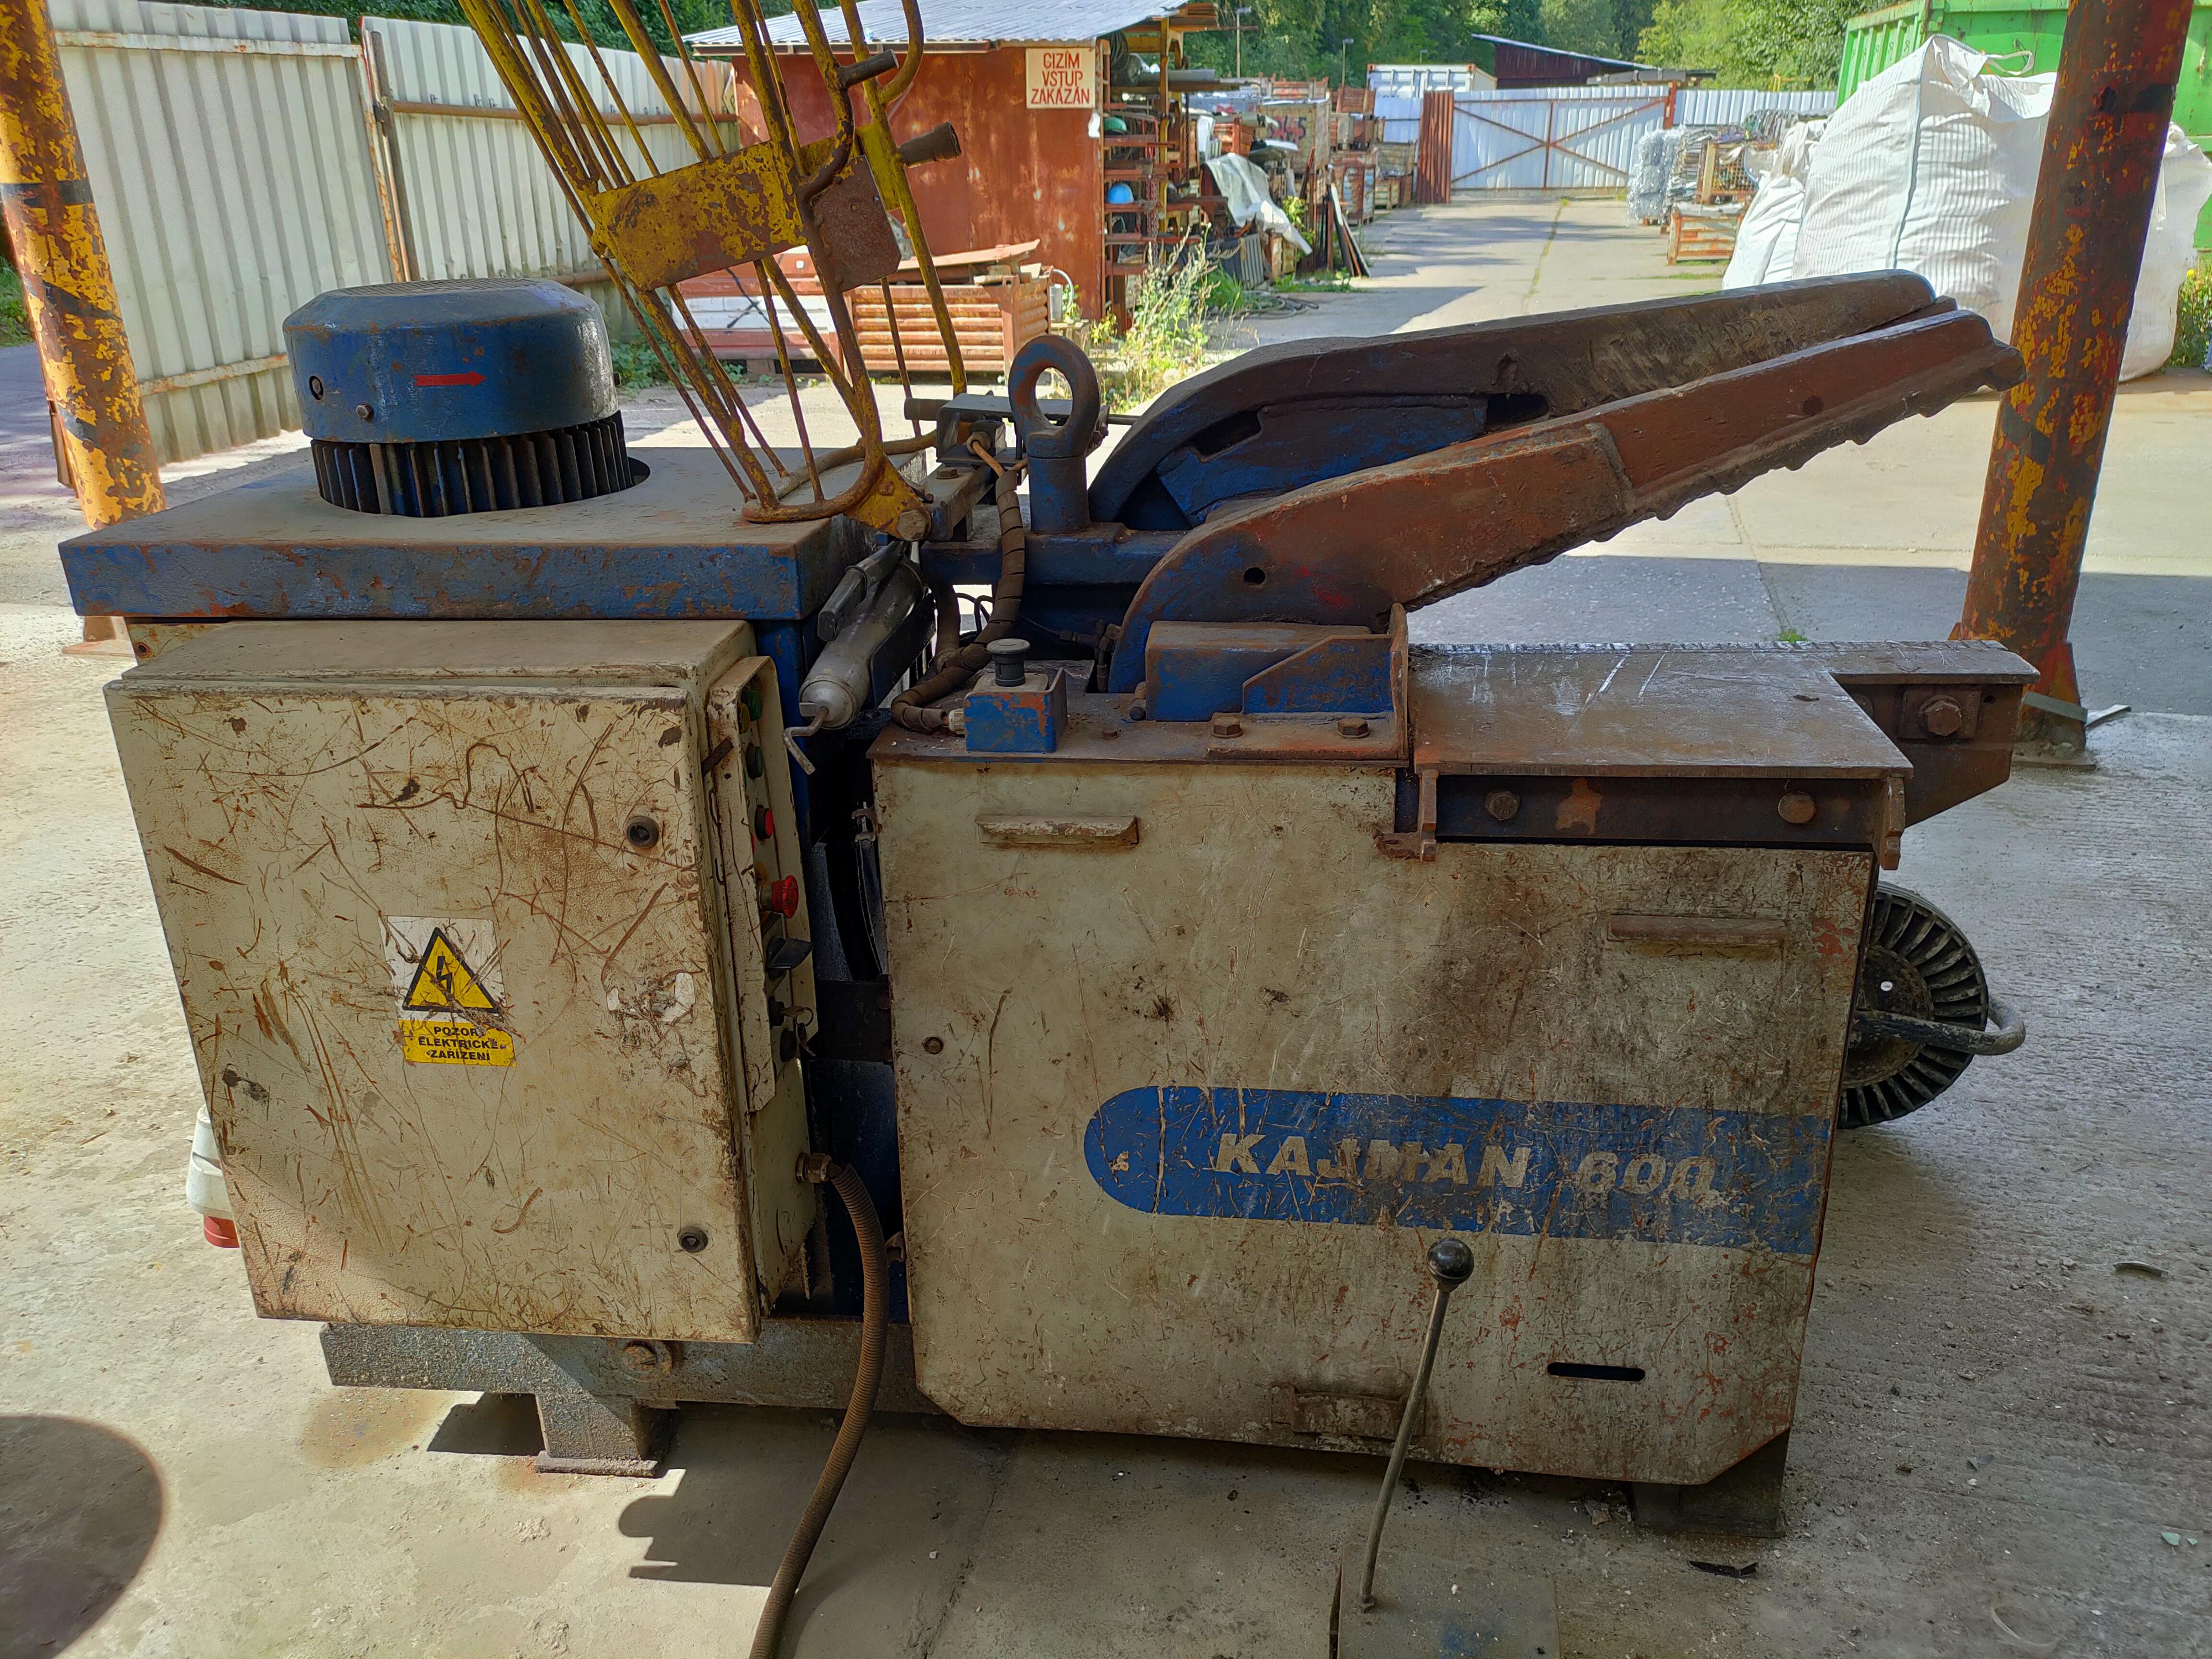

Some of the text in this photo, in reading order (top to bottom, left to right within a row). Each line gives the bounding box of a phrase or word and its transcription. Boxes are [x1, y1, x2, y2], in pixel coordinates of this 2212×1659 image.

[1042, 71, 1083, 87] VSTUP
[1031, 87, 1090, 104] ZAKÁZÁN
[430, 1048, 491, 1061] ZAŘÍZENÍ
[1216, 1133, 1532, 1188] KAJMAN
